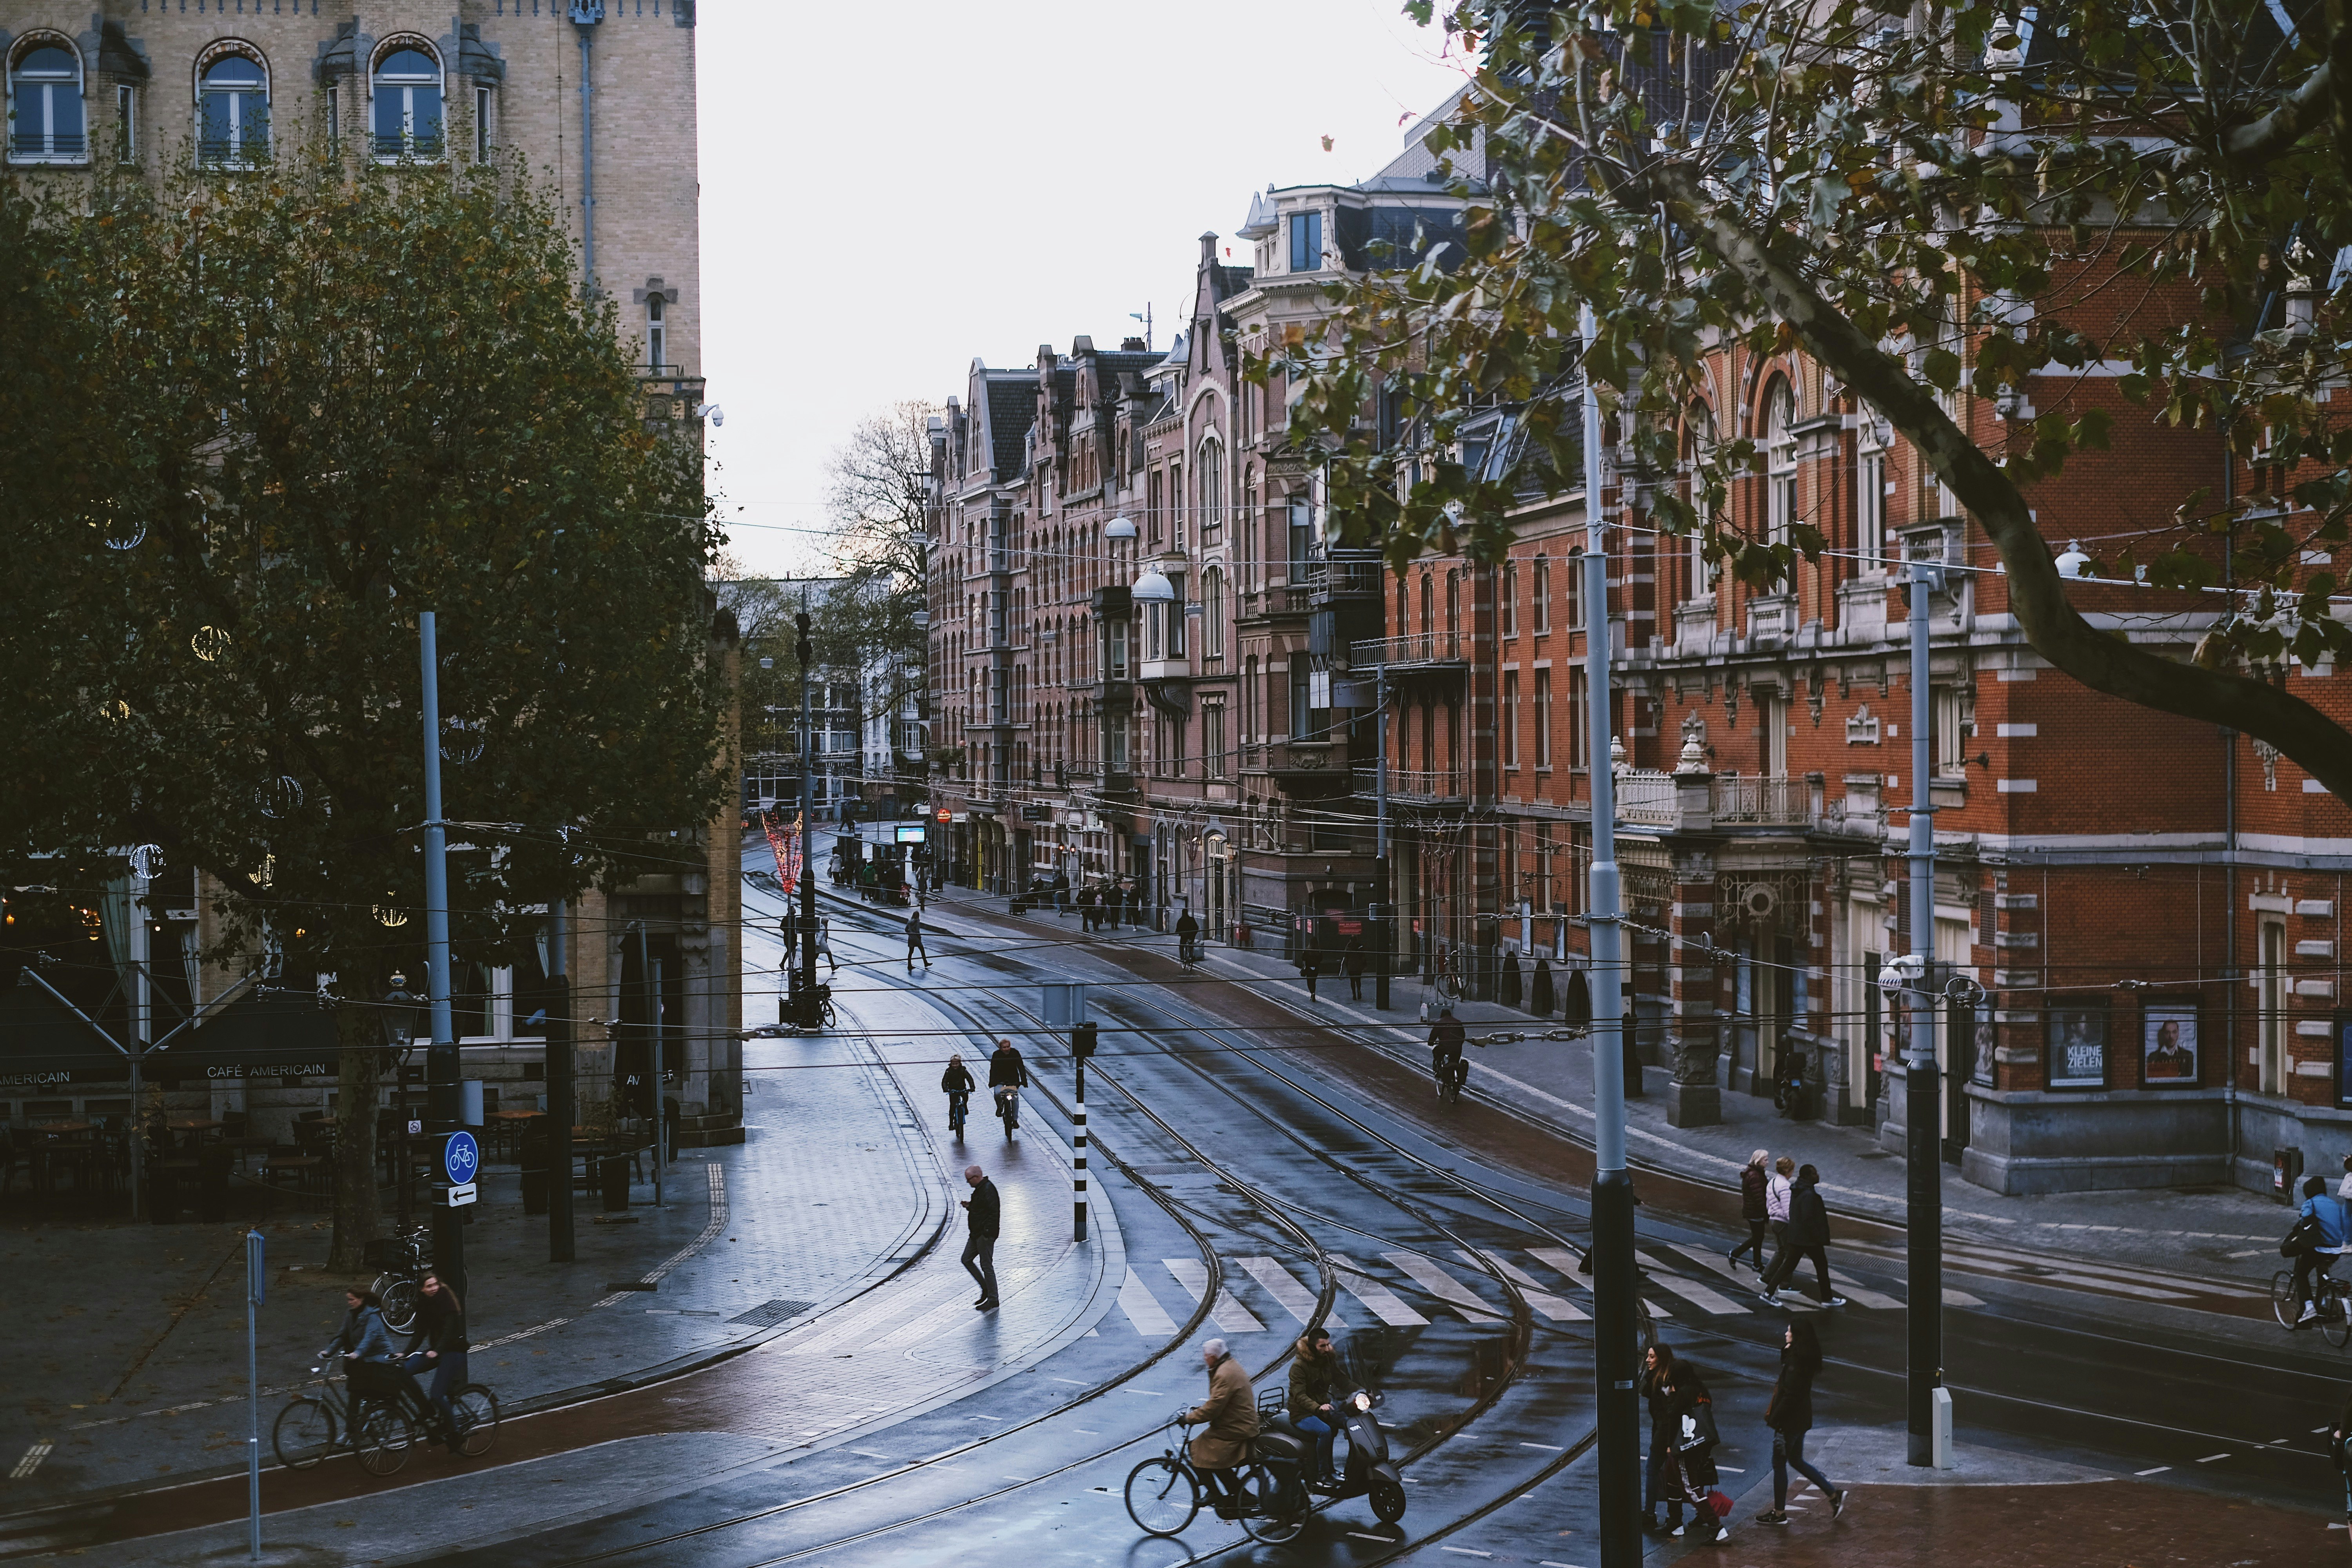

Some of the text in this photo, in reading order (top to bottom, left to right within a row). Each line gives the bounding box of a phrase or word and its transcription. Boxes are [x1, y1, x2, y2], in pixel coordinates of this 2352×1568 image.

[2067, 1045, 2102, 1057] KLEINE
[2067, 1056, 2103, 1069] ZIELEN
[207, 1063, 325, 1077] CAFÉ AMERICAIN
[0, 1071, 70, 1085] MERICAIN
